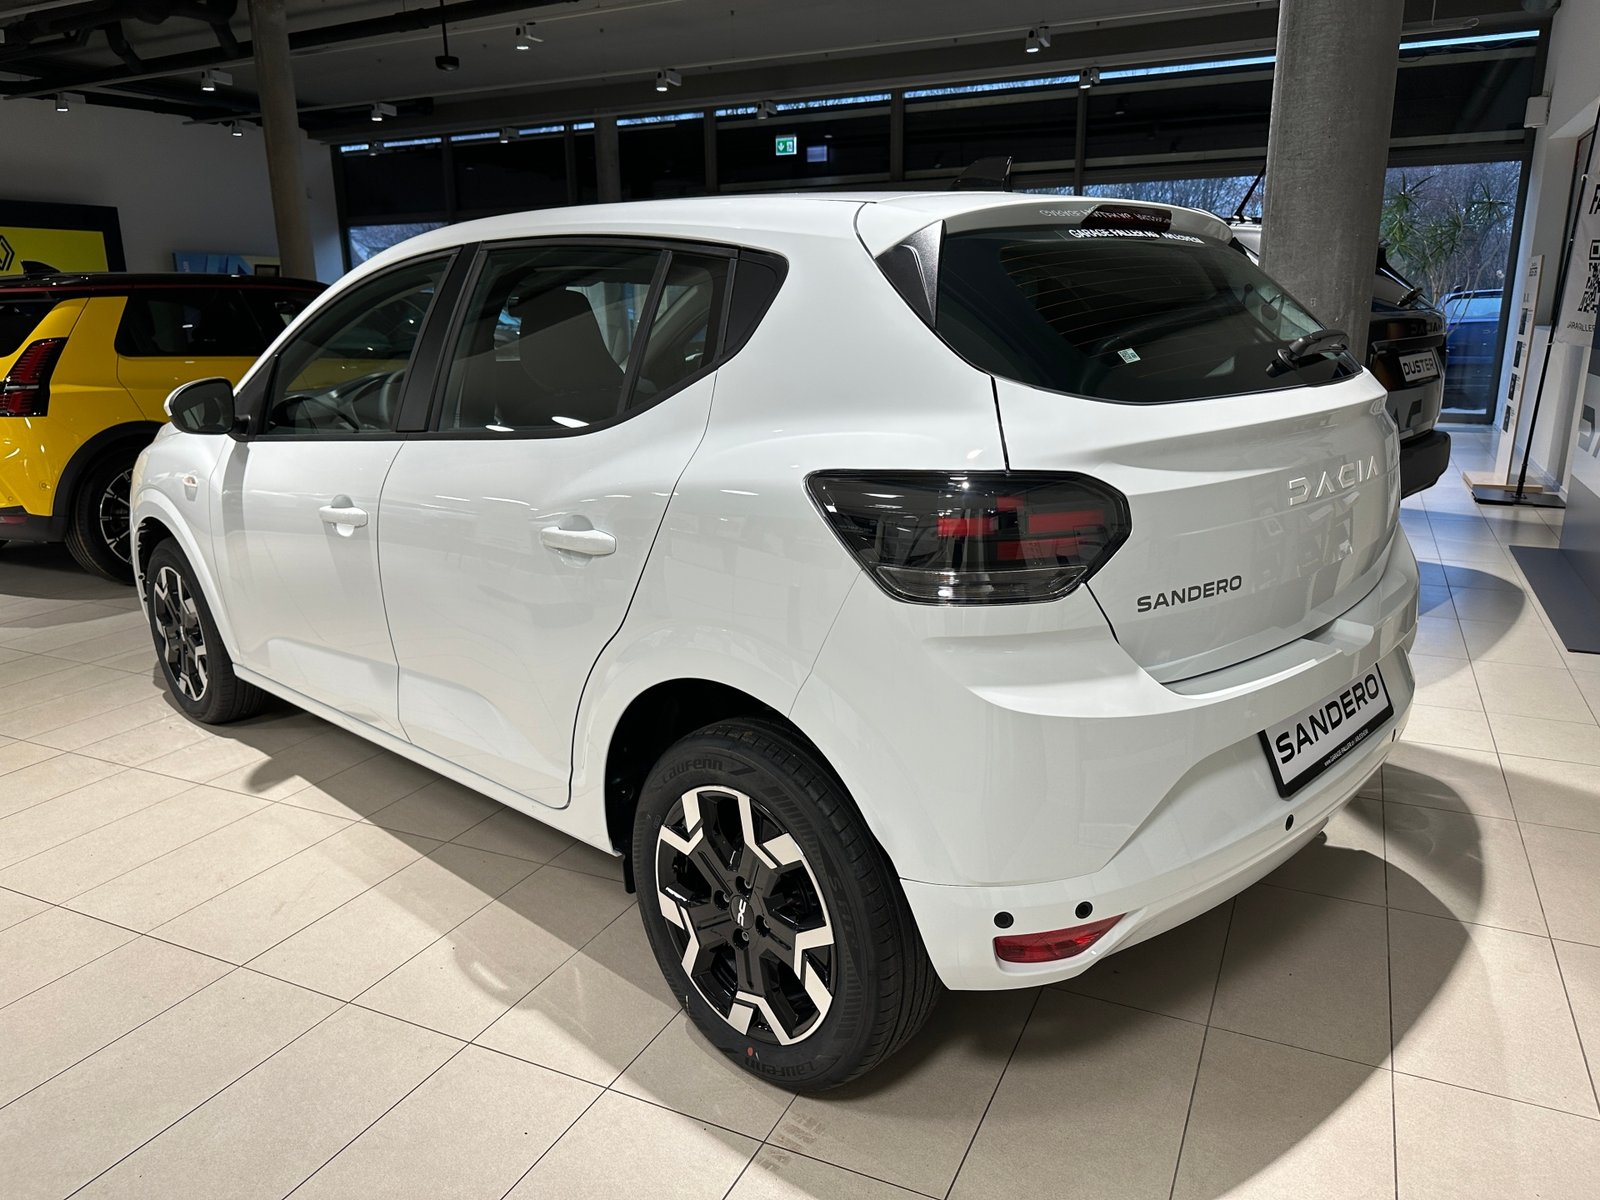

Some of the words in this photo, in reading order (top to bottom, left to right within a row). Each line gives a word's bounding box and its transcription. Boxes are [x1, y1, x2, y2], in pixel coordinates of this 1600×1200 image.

[1402, 357, 1435, 376] DUSTER
[1288, 455, 1378, 506] DACIA
[1137, 575, 1242, 613] SANDERO
[1275, 673, 1380, 765] SANDERO
